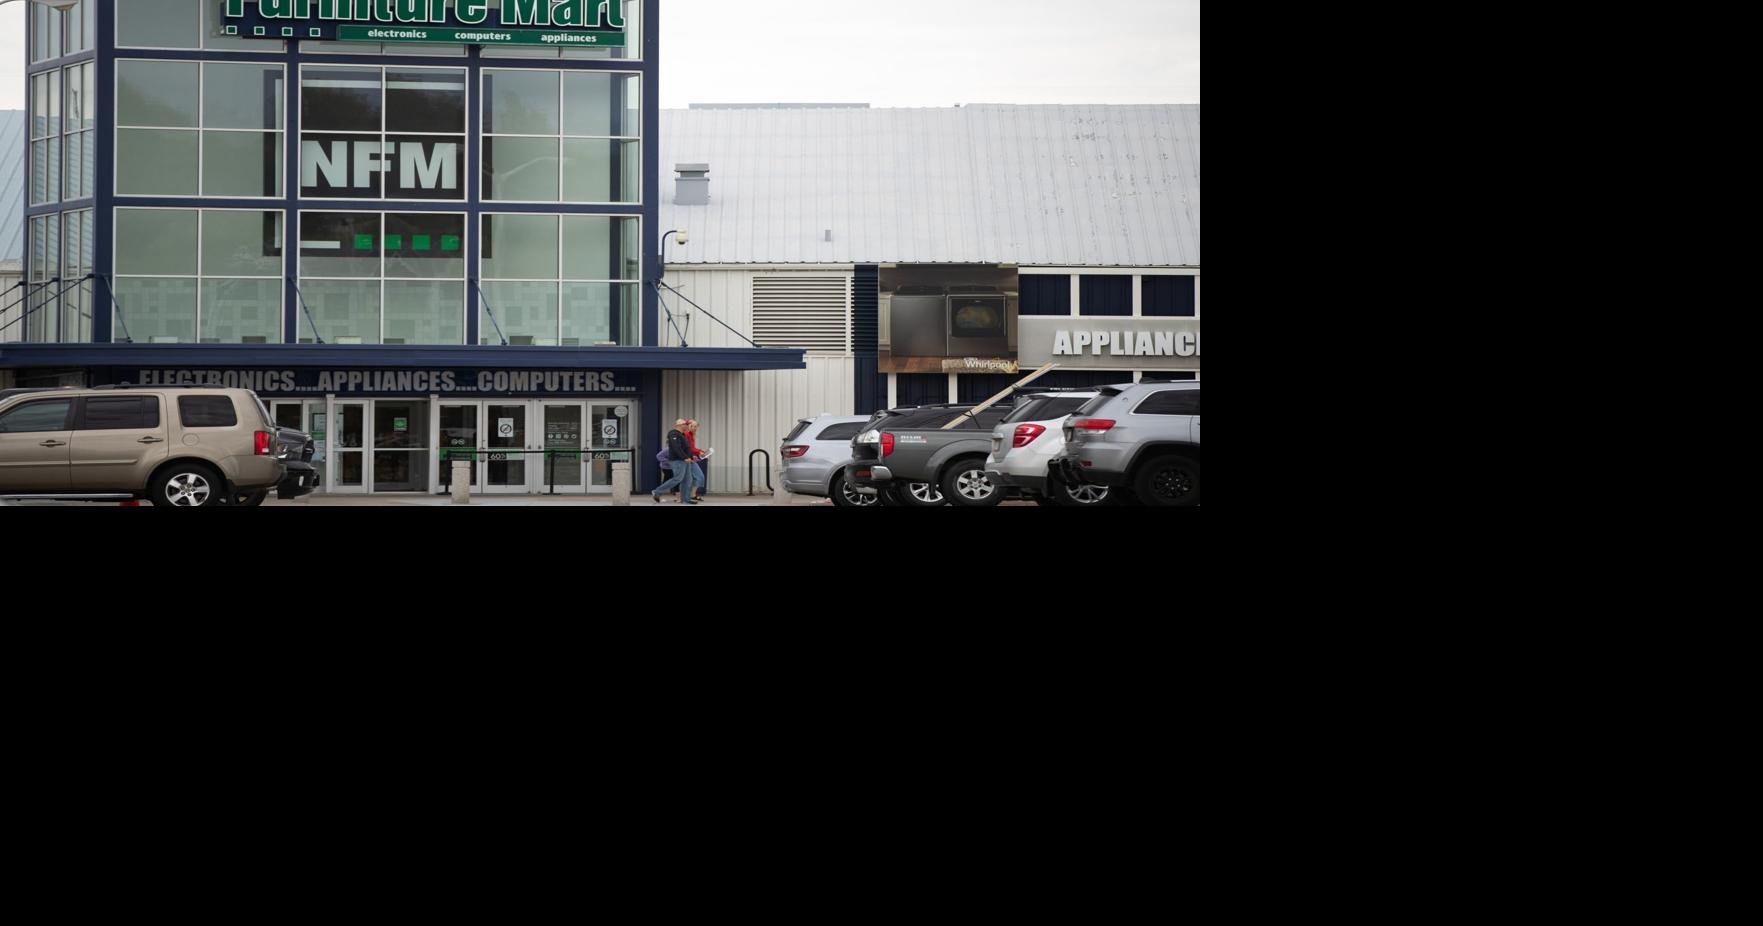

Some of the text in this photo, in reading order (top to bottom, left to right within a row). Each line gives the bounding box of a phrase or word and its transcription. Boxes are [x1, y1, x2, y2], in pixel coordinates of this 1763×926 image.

[500, 0, 626, 28] Mart
[367, 28, 597, 43] electronics computers appliances
[301, 140, 457, 190] NFM
[1052, 330, 1200, 357] APPLIANC
[965, 359, 1010, 370] Whirlpool
